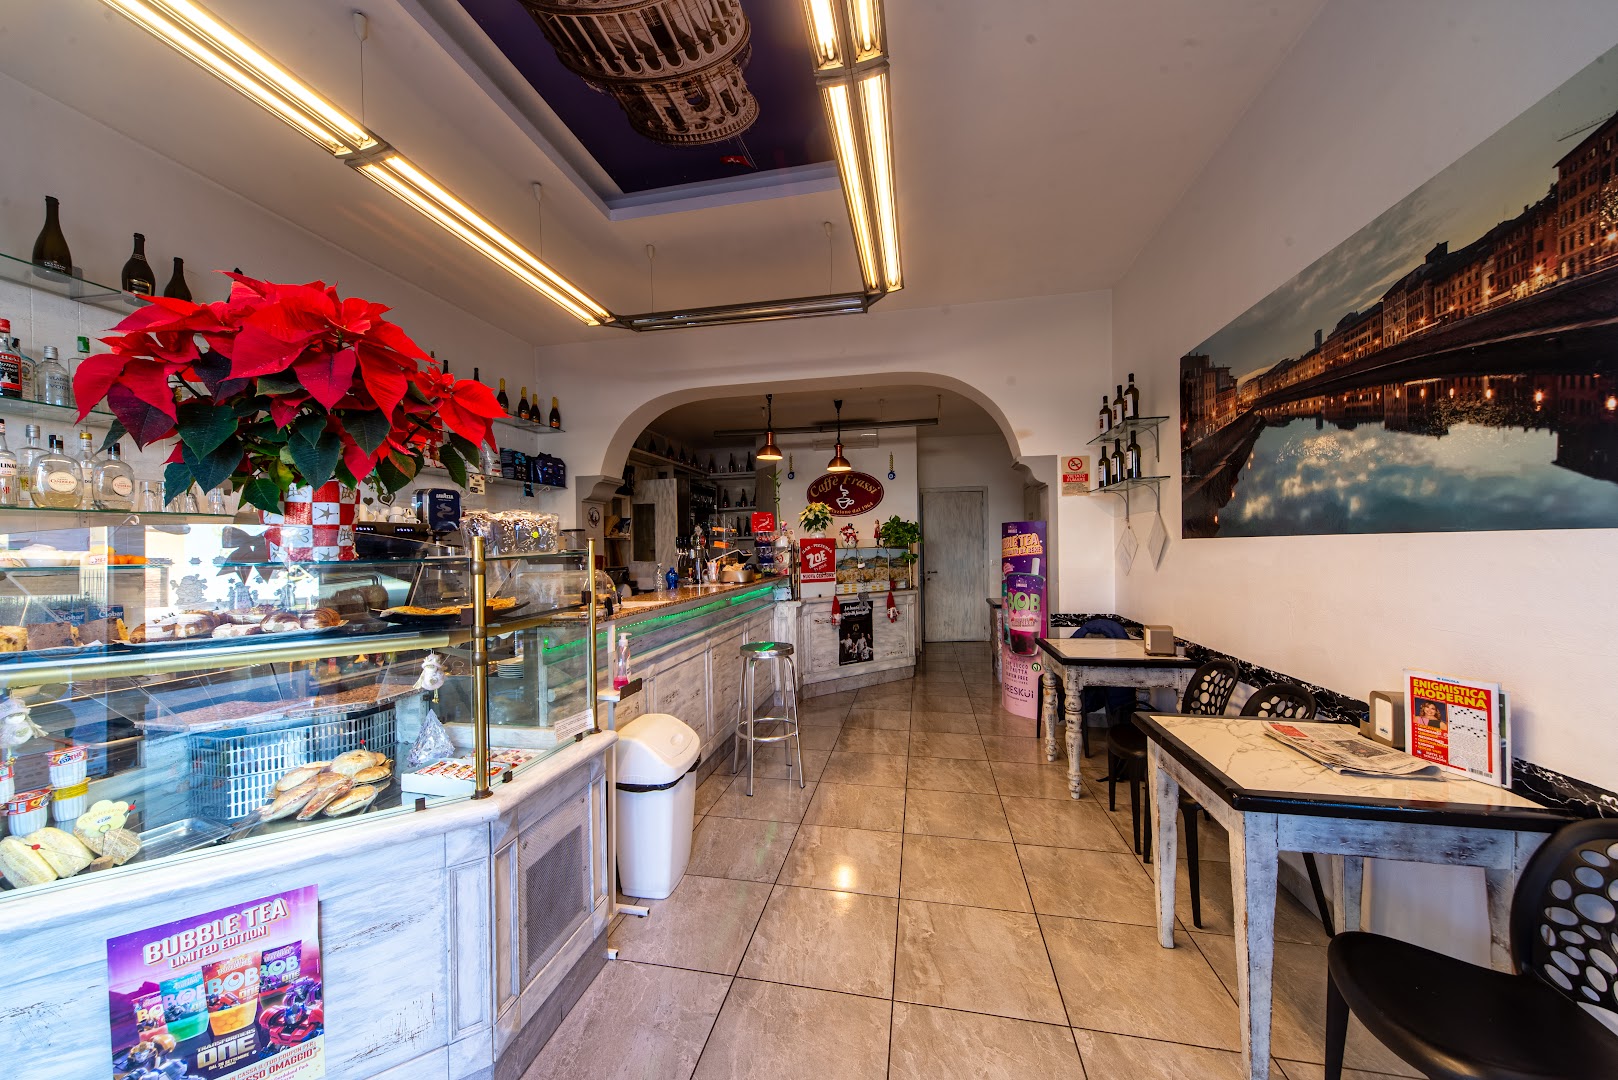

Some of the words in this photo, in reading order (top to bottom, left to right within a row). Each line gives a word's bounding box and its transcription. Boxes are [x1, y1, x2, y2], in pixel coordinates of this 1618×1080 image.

[810, 475, 839, 497] Caffè
[843, 474, 880, 494] Frassi
[1018, 533, 1040, 547] TEA
[1008, 592, 1040, 612] BOB
[1413, 679, 1487, 700] ENIGMISTICA
[1413, 687, 1487, 709] MODERNA
[145, 913, 240, 964] BUBBLE
[245, 899, 288, 927] TEA
[170, 944, 219, 968] LIMITED
[222, 925, 268, 948] EDITION
[261, 955, 299, 977] BOB
[207, 968, 259, 995] BOB
[197, 1028, 256, 1052] TRANSFORMERS
[197, 1033, 257, 1069] ONE
